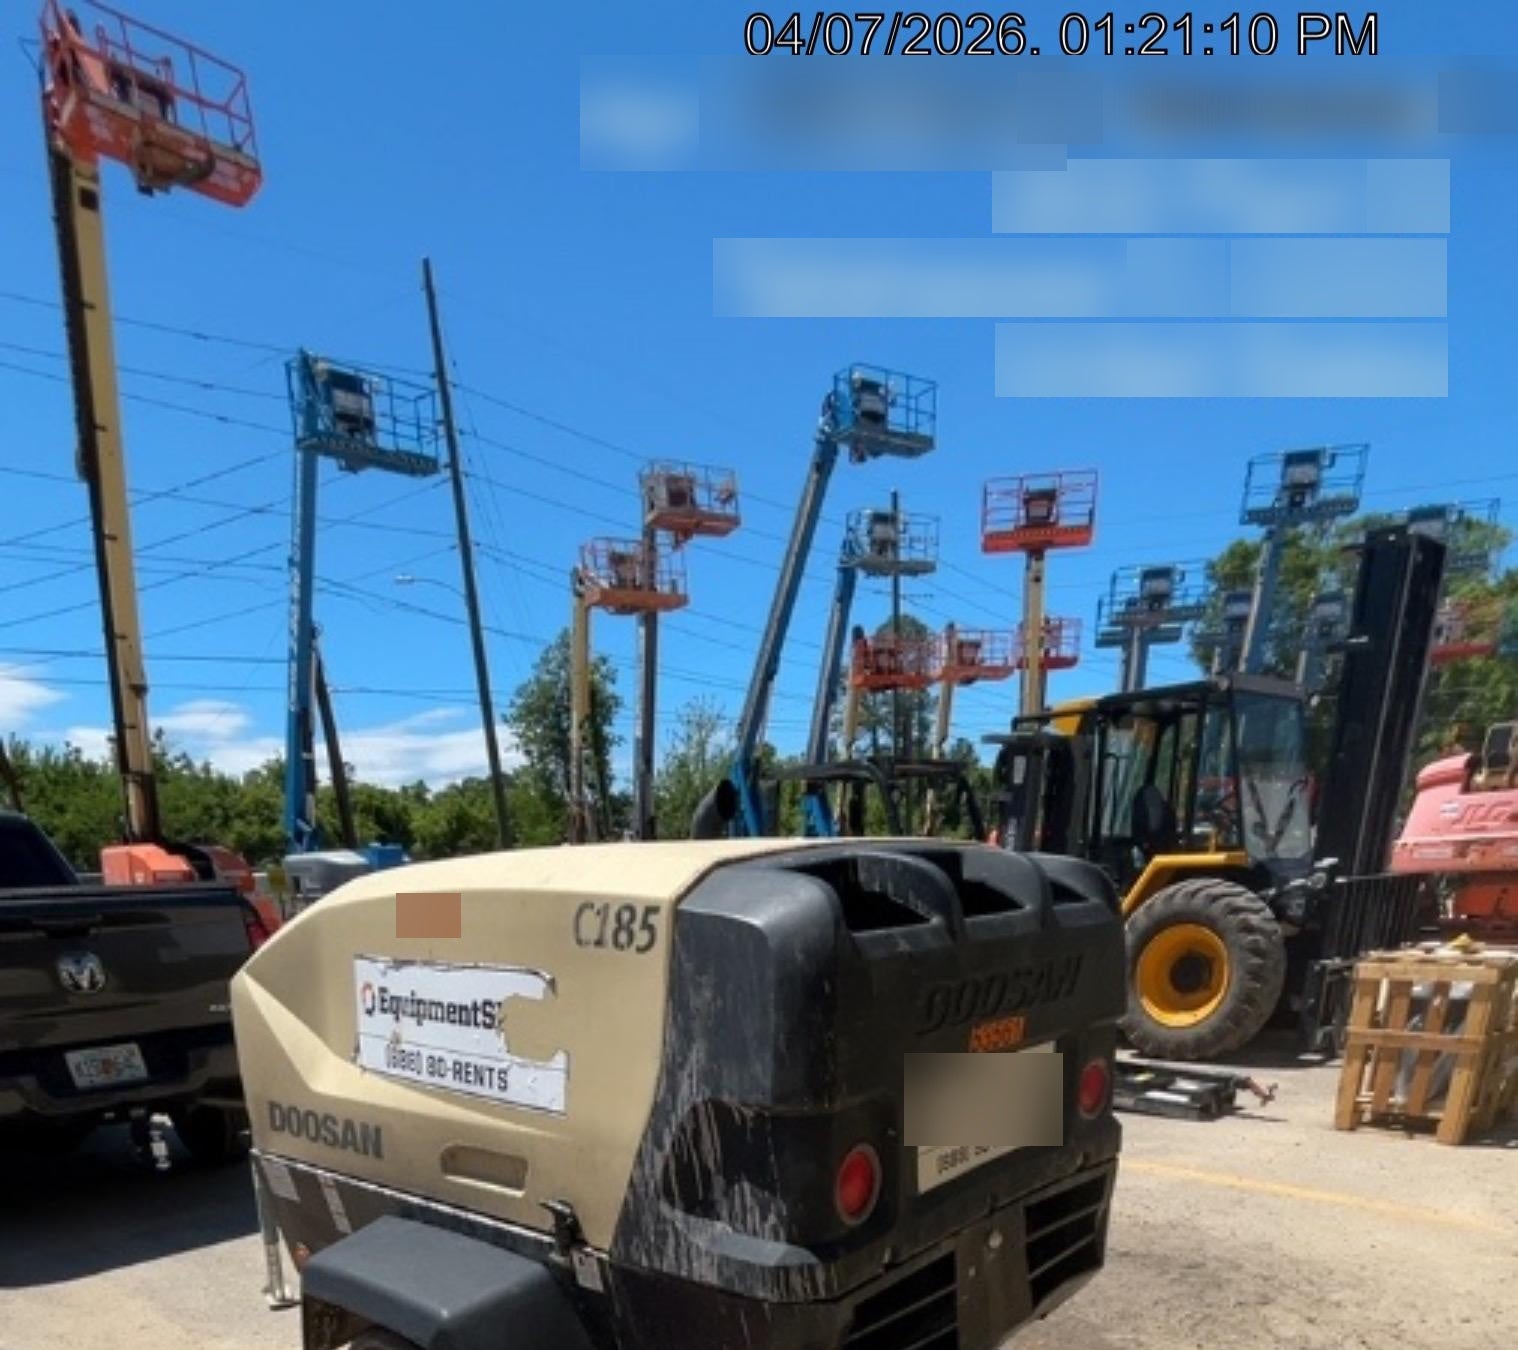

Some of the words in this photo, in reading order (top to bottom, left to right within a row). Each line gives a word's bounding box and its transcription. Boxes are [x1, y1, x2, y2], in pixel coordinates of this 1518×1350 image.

[574, 902, 661, 954] C185
[378, 987, 506, 1031] EquipmentS
[916, 953, 1083, 1034] DOOSAN
[268, 1101, 383, 1159] DOOSAN
